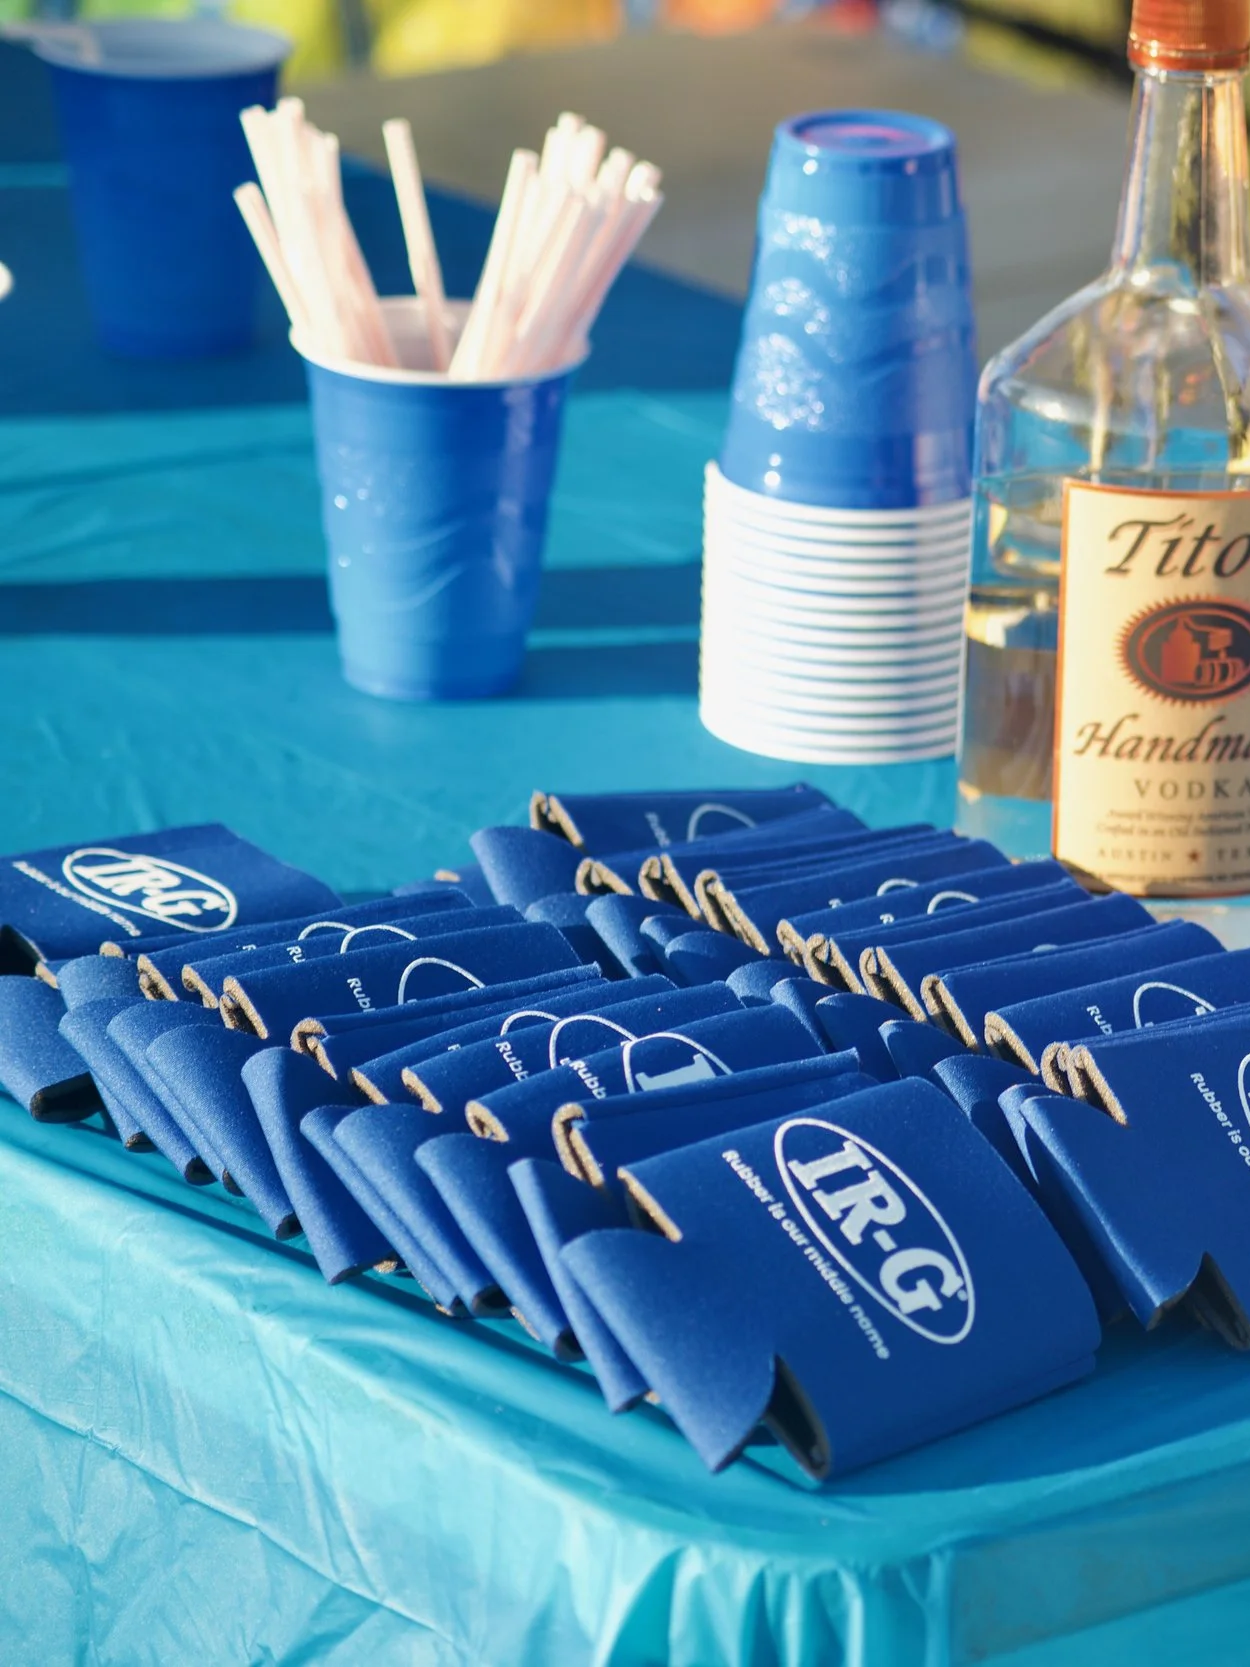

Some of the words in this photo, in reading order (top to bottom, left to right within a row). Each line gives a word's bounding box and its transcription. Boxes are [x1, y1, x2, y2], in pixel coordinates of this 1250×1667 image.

[1190, 1072, 1233, 1128] Rubber
[1227, 1128, 1242, 1145] is
[722, 1149, 775, 1204] Rubber
[768, 1203, 786, 1220] is
[782, 1219, 810, 1247] our
[803, 1246, 855, 1305] middle
[849, 1304, 890, 1360] name
